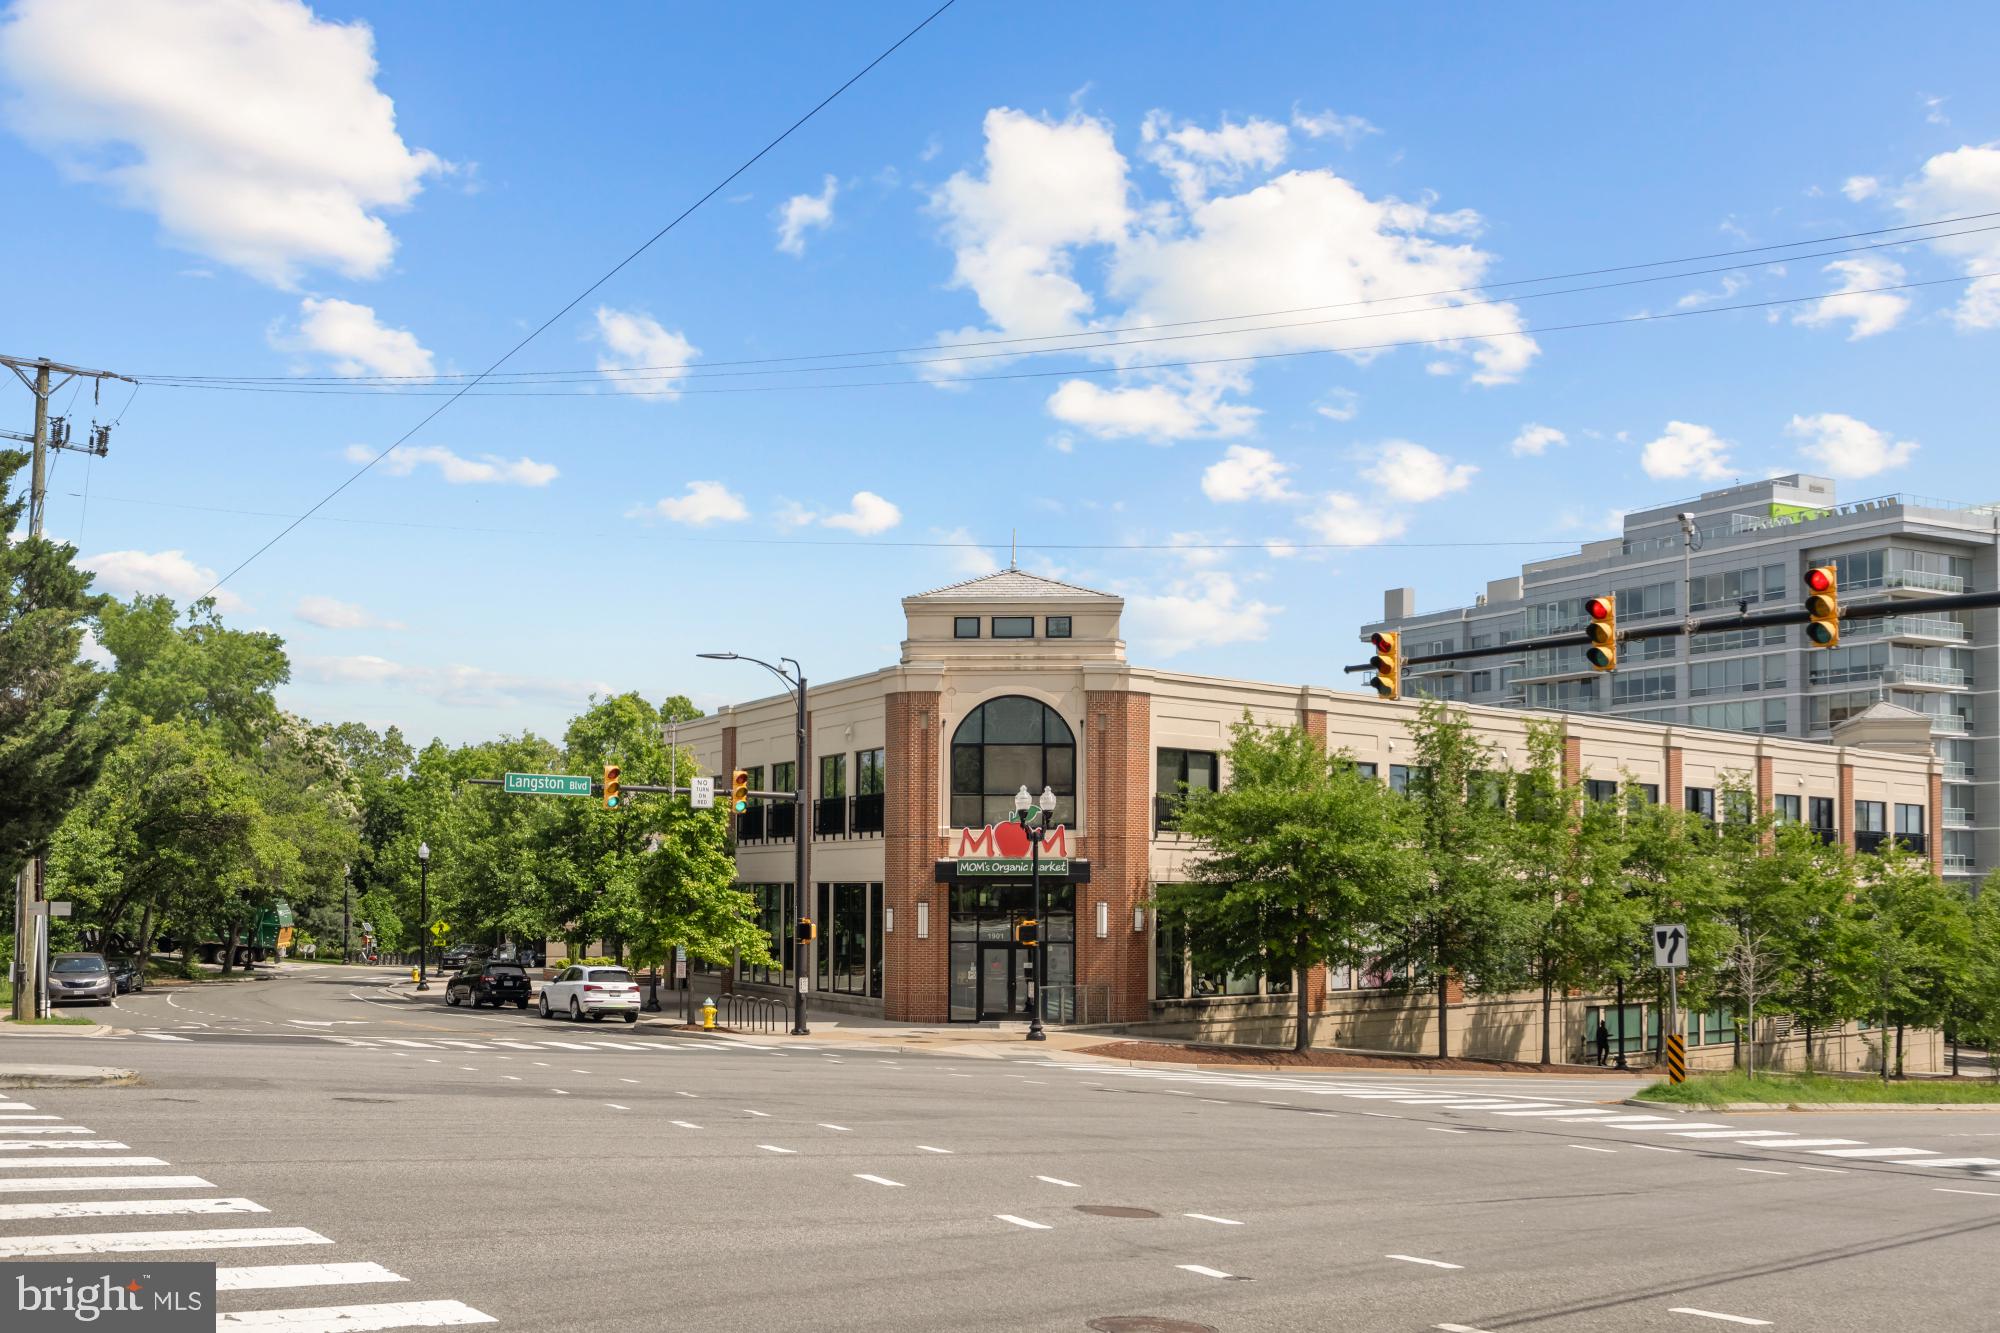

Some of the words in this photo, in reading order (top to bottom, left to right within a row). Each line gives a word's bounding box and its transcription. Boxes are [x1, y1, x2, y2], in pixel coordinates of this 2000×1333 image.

[509, 774, 564, 791] Langston
[569, 781, 588, 791] Blvd
[991, 861, 1028, 874] Organic
